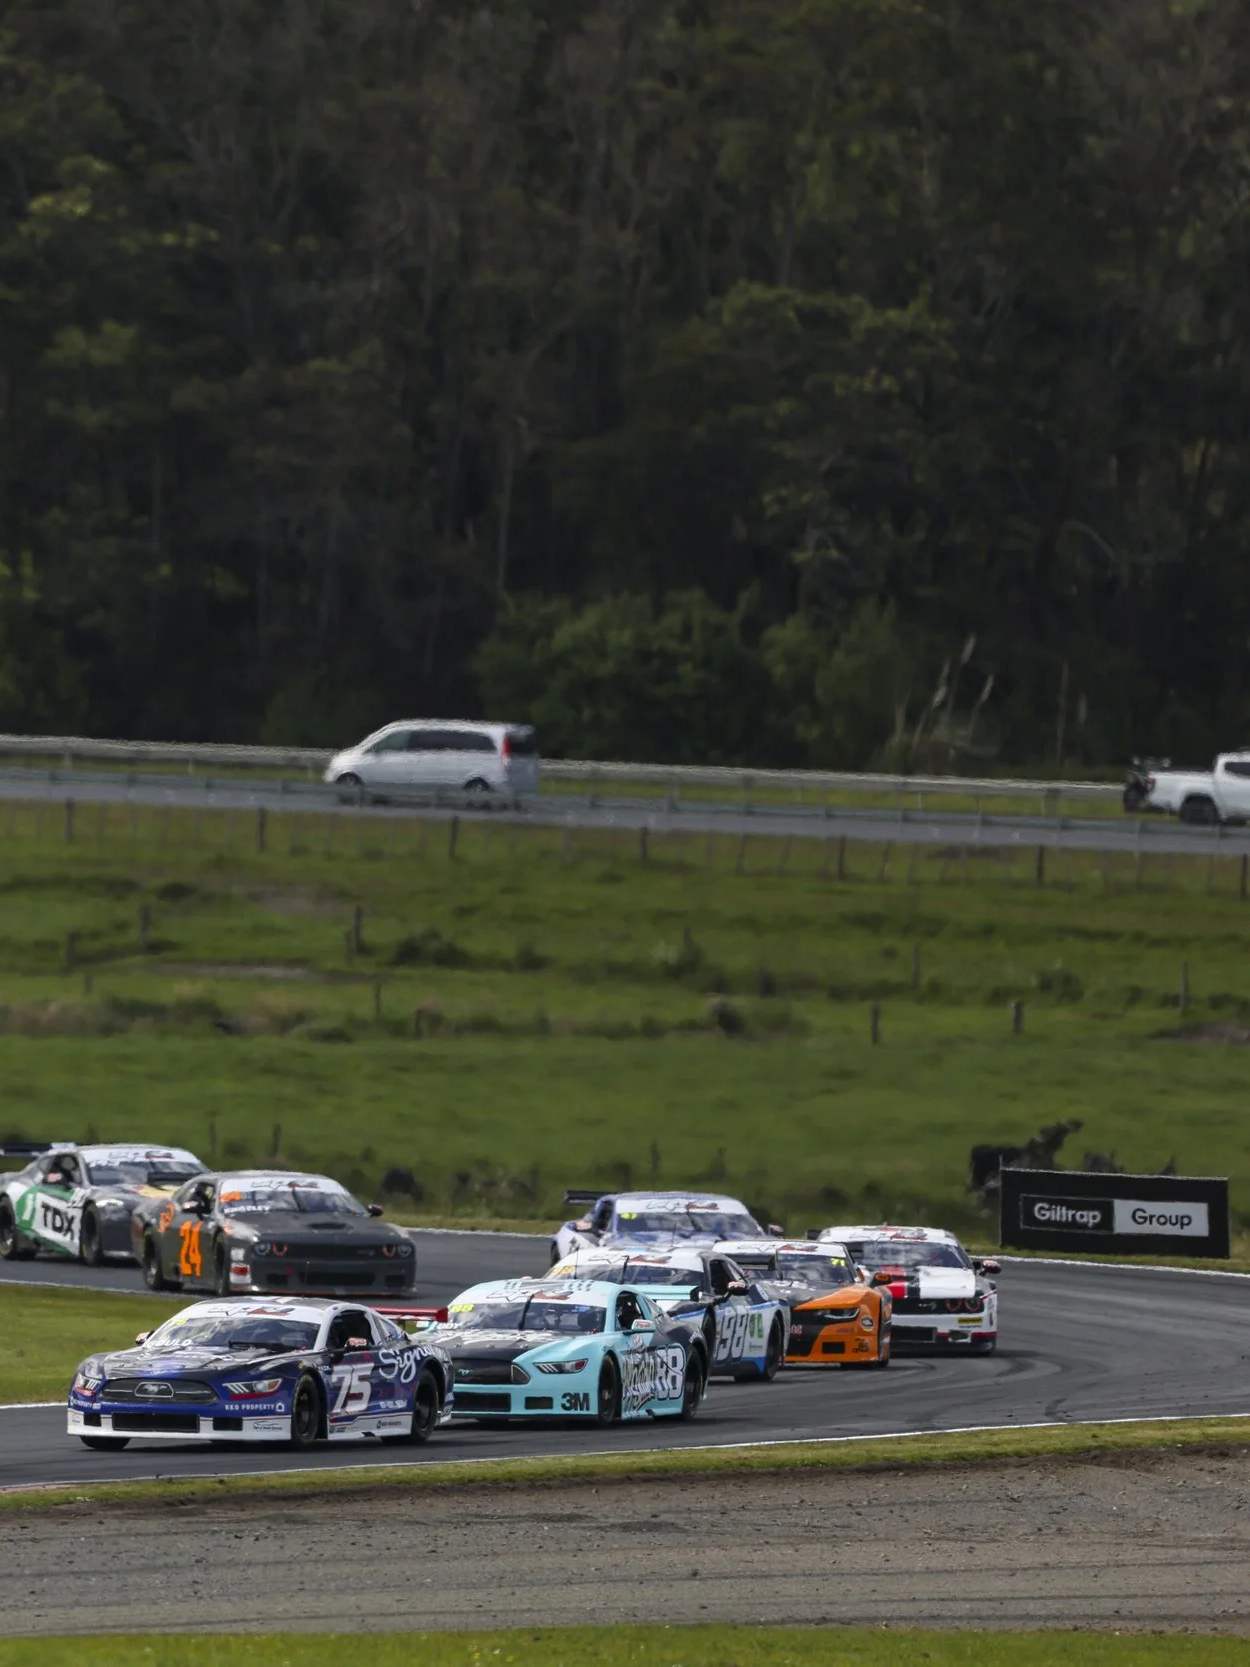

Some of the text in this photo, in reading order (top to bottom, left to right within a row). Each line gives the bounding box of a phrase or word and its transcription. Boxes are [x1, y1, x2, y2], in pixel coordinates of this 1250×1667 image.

[41, 1201, 75, 1241] TDX
[1034, 1202, 1193, 1230] Giltrap Group
[331, 1363, 374, 1413] 75
[655, 1343, 686, 1401] 88
[561, 1392, 590, 1411] 3M
